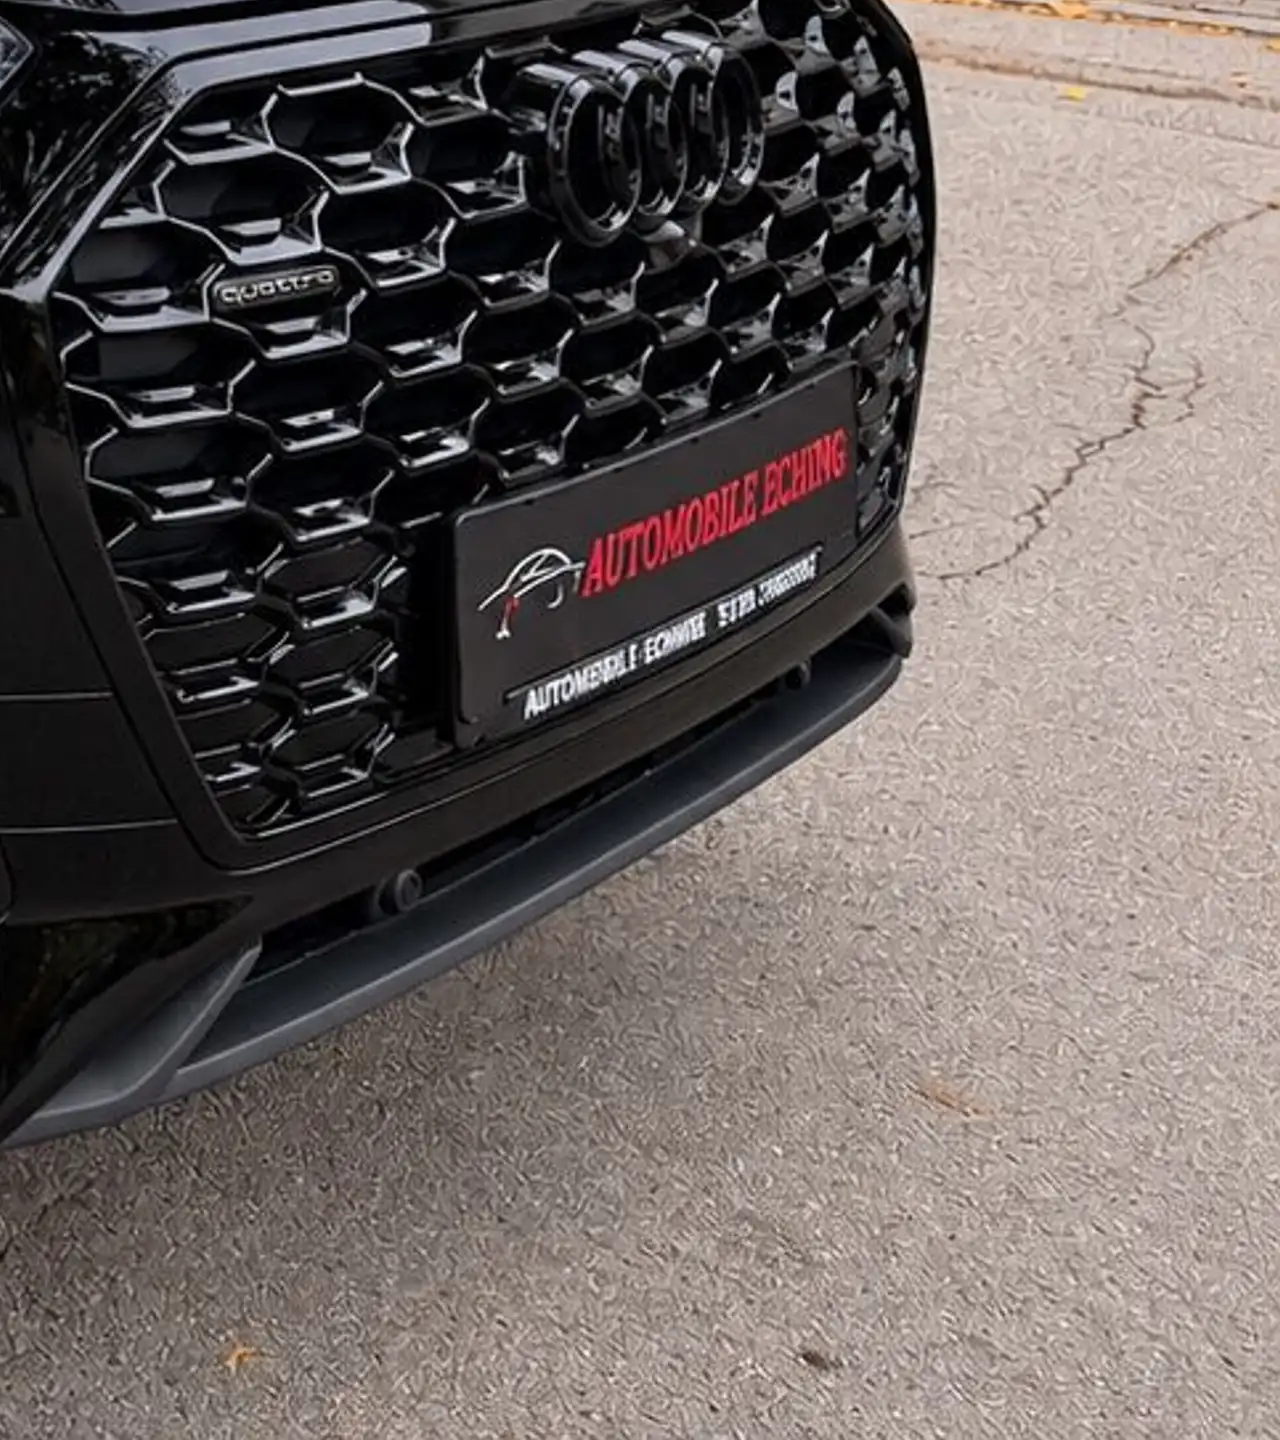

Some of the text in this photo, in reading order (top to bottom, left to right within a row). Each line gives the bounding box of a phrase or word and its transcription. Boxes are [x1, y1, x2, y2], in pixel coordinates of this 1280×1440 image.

[220, 270, 335, 305] quattro
[580, 469, 759, 595] AUTOMOBILE
[760, 427, 849, 517] ECHING
